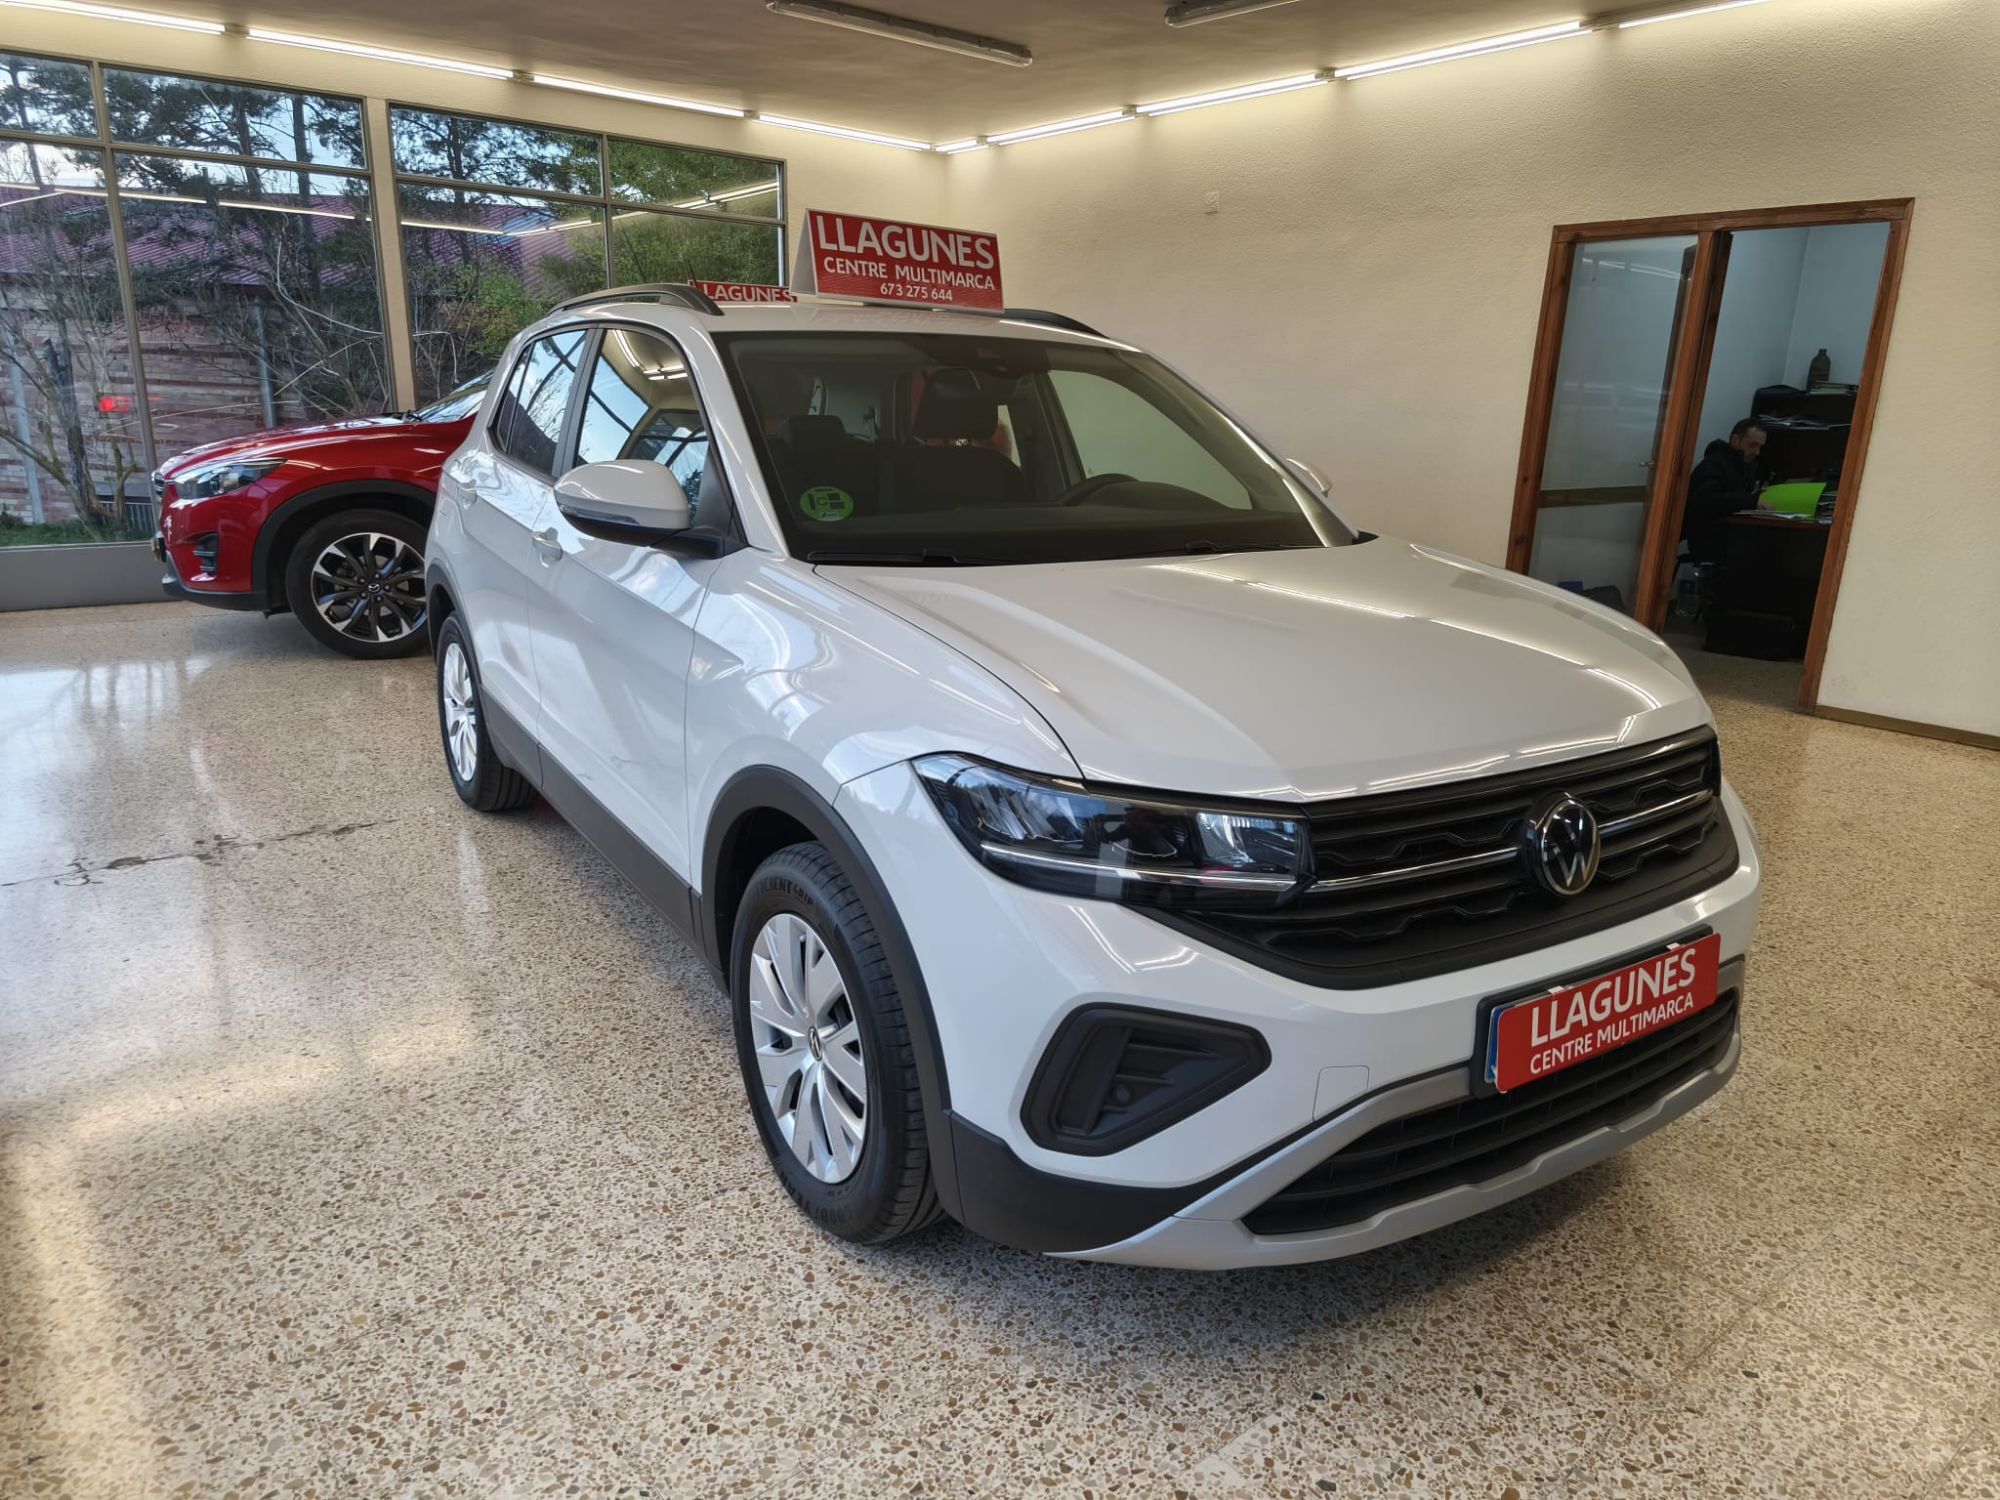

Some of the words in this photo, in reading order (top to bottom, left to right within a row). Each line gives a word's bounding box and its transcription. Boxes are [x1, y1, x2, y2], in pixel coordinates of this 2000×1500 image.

[816, 215, 995, 270] LLAGUNES
[692, 282, 794, 302] LAGUNES
[823, 256, 887, 278] CENTRE
[895, 265, 995, 291] MULTIMARCA
[880, 282, 903, 297] 673
[906, 285, 928, 299] 275
[931, 287, 953, 301] 644
[1531, 948, 1696, 1048] LLAGUNES
[1530, 1036, 1593, 1075] CENTRE
[1596, 992, 1694, 1049] MULTIMARCA
